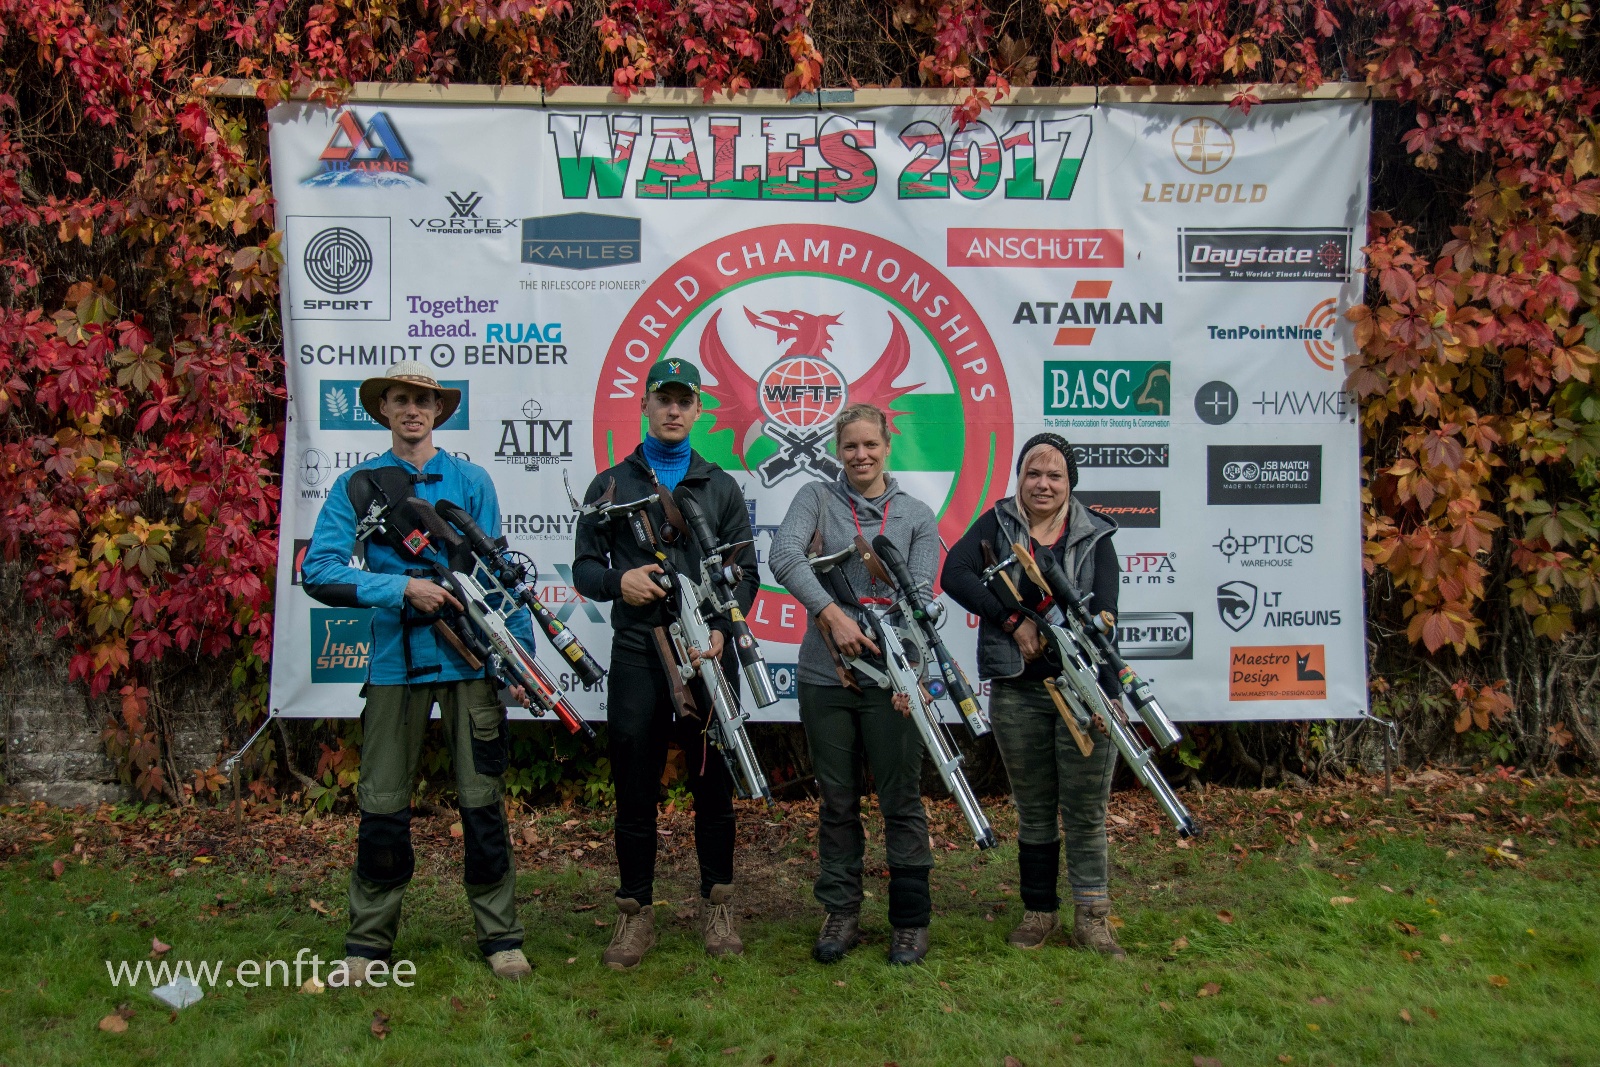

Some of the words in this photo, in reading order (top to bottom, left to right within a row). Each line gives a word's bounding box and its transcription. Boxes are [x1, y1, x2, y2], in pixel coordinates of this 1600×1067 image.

[548, 114, 878, 203] WALES
[899, 114, 1093, 201] 2017
[319, 161, 350, 172] AIR
[356, 161, 409, 173] ARMS
[1141, 183, 1268, 203] LEUPOLD
[409, 218, 518, 228] VORTEX
[529, 245, 634, 260] KAHLES
[1188, 245, 1314, 268] Daystate
[322, 245, 355, 278] STEYR
[1229, 270, 1244, 278] The
[1276, 270, 1300, 278] Finest
[1302, 270, 1331, 279] Airguns
[520, 280, 539, 291] THE
[541, 280, 597, 291] RIFLESCOPE
[303, 299, 373, 311] SPORT
[406, 296, 499, 317] Together
[609, 274, 700, 400] WORLD
[716, 238, 996, 402] CHAMPIONSHIPS
[1012, 302, 1163, 325] ATAMAN
[407, 319, 477, 338] ahead.
[486, 323, 562, 343] RUAG
[1207, 325, 1323, 340] TenPointNine
[300, 344, 422, 366] SCHMIDT
[464, 344, 568, 366] BENDER
[764, 385, 842, 403] WFTF
[1050, 368, 1131, 410] BASC
[353, 408, 379, 424] Eng
[1043, 418, 1053, 428] The
[1054, 418, 1071, 428] British
[1072, 418, 1100, 428] Association
[1109, 418, 1132, 430] Shooting
[1138, 418, 1170, 428] Conservation
[494, 419, 573, 457] AIM
[506, 456, 529, 465] FIELD
[531, 456, 560, 465] SPORTS
[1261, 461, 1278, 470] JSB
[1280, 461, 1309, 470] MATCH
[1261, 470, 1309, 482] DIABOLO
[500, 514, 578, 534] HRONY
[1217, 535, 1313, 557] OPTICS
[1119, 557, 1176, 573] PPA
[1240, 558, 1293, 568] WAREHOUSE
[533, 586, 588, 603] MEX
[1263, 591, 1283, 607] LT
[1263, 609, 1341, 627] AIRGUNS
[330, 642, 371, 655] H&N
[316, 656, 370, 669] SPOR
[1232, 652, 1290, 666] Maestro
[1232, 670, 1280, 687] Design
